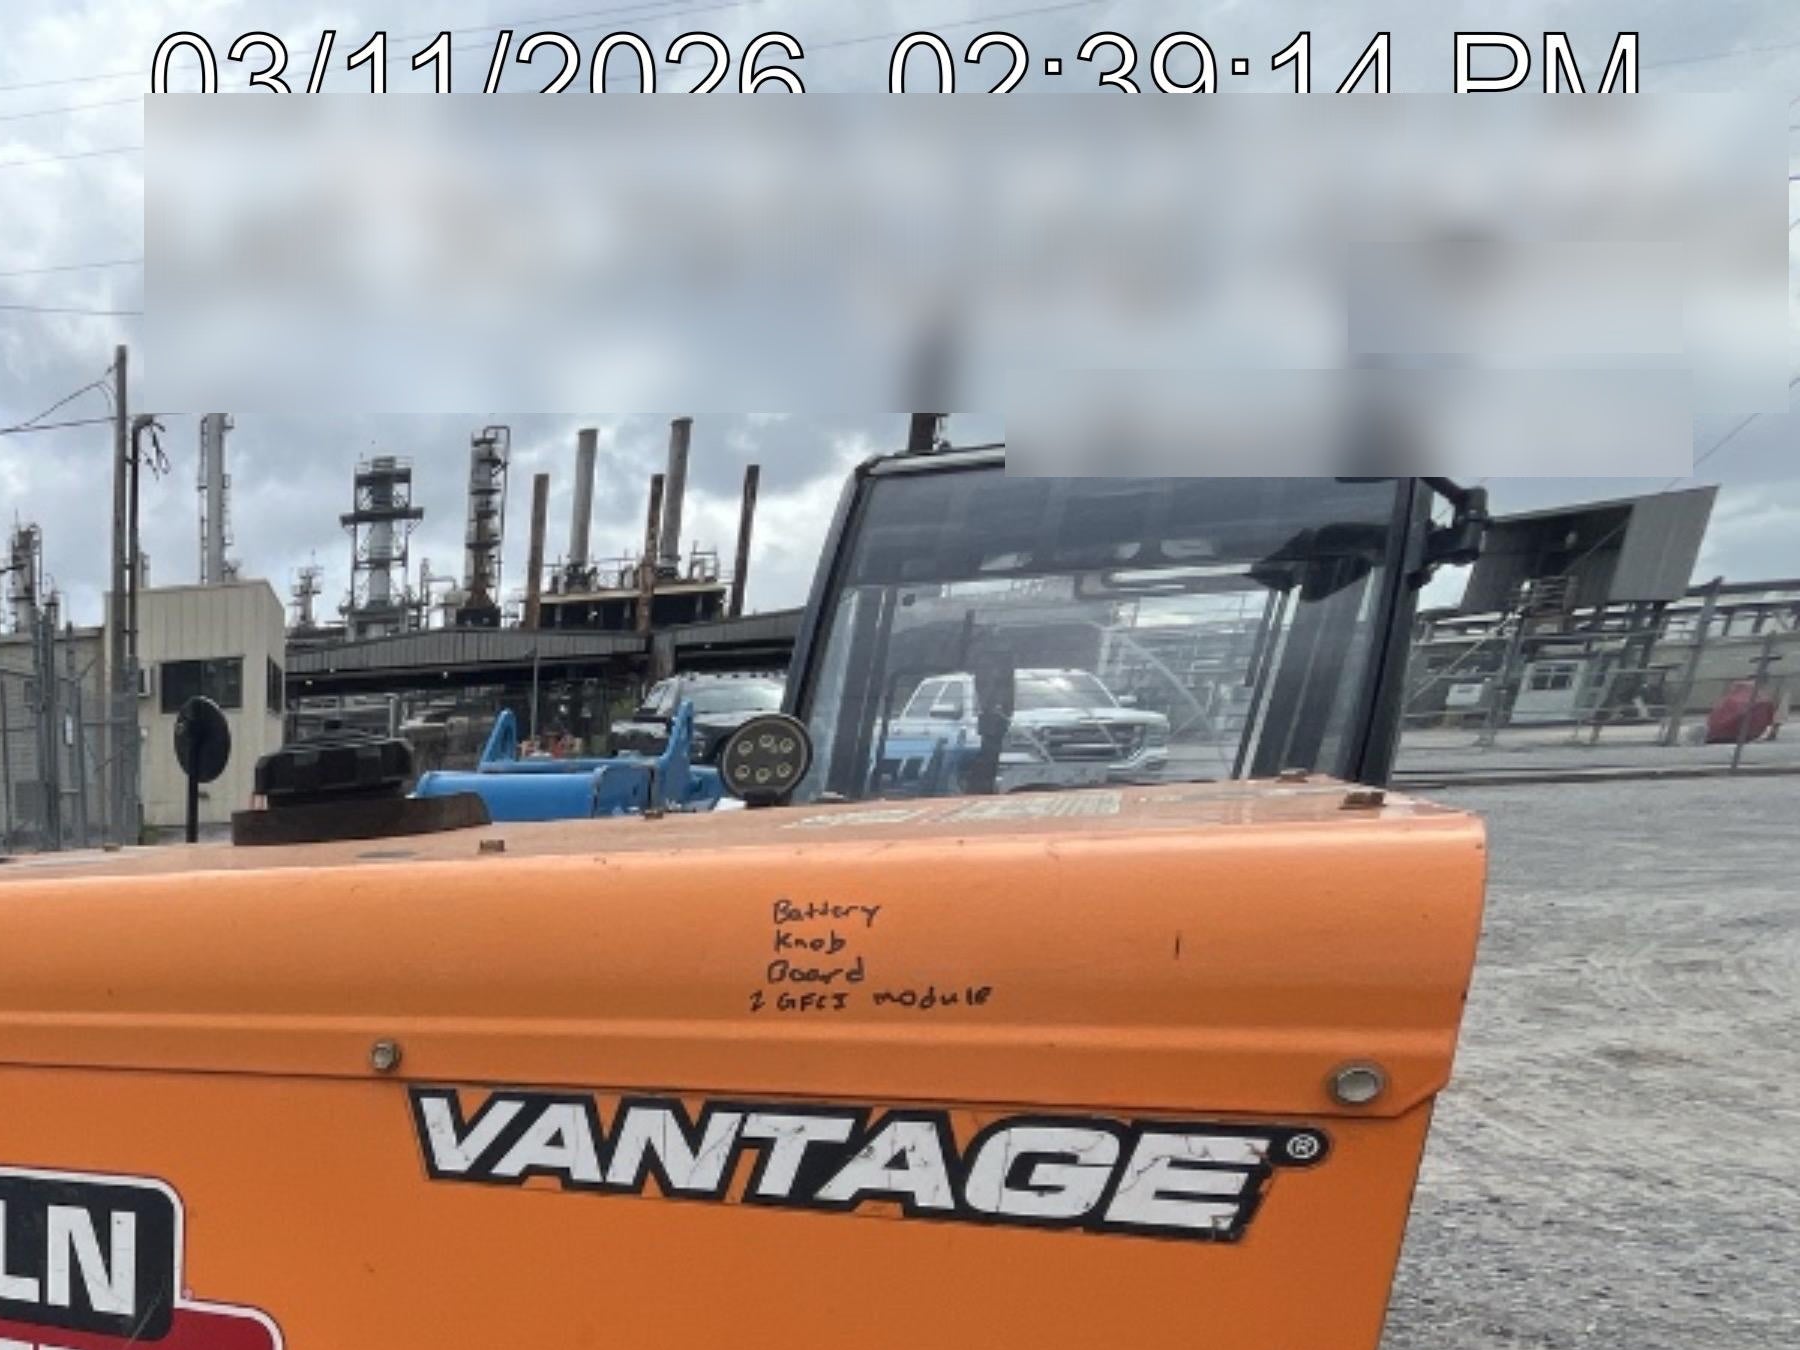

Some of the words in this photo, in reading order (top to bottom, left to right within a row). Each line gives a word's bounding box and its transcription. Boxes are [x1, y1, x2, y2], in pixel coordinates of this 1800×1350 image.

[773, 899, 881, 928] Battery
[767, 957, 865, 984] Board
[418, 1097, 1270, 1229] VANTAGE
